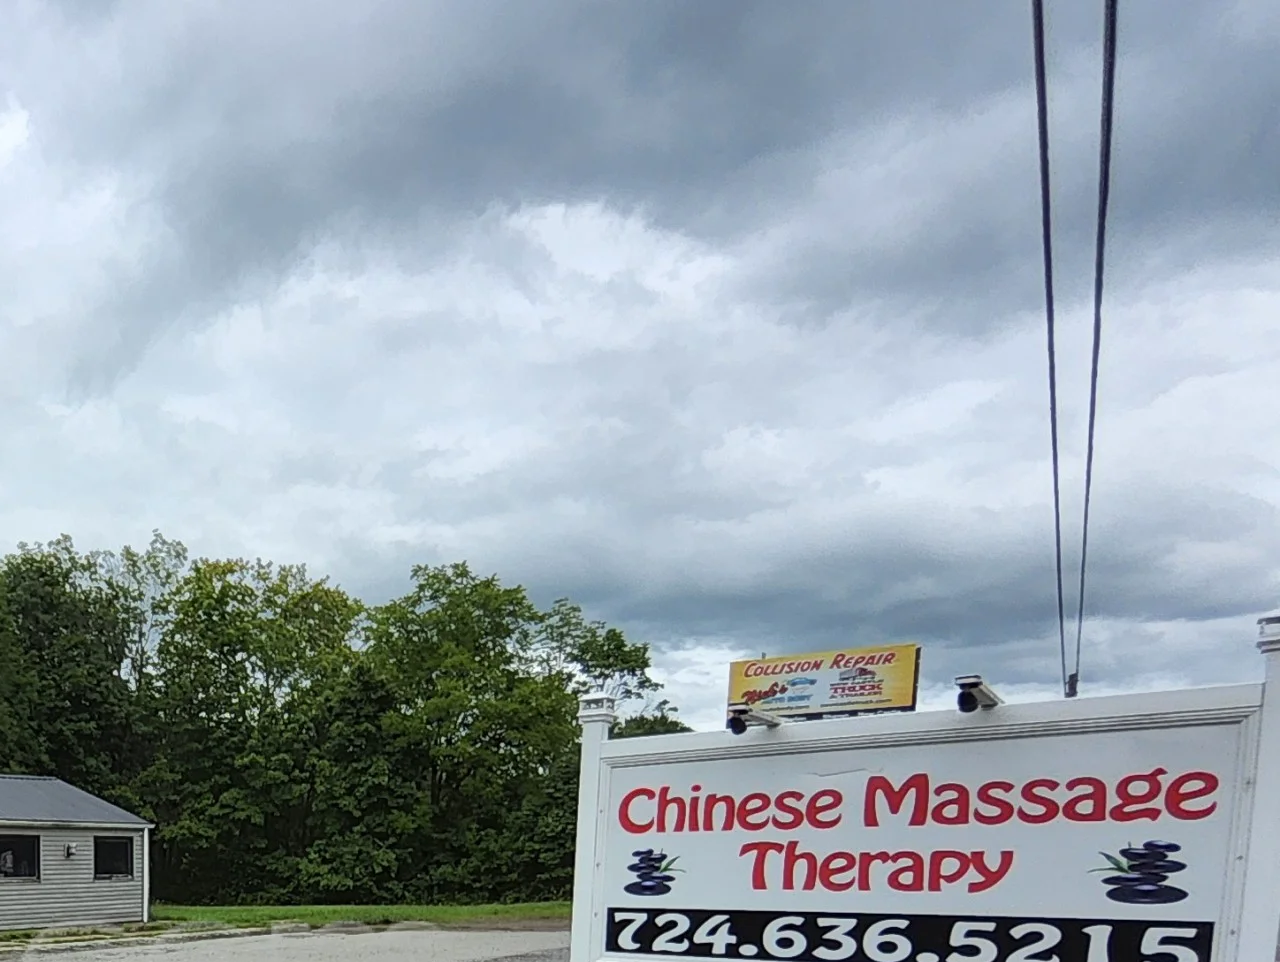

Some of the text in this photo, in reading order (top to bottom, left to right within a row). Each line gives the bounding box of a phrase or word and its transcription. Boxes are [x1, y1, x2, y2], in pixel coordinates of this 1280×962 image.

[744, 652, 896, 678] COLLISION REPAIR
[619, 768, 1219, 833] Chinese Massage
[739, 840, 1014, 893] Therapy
